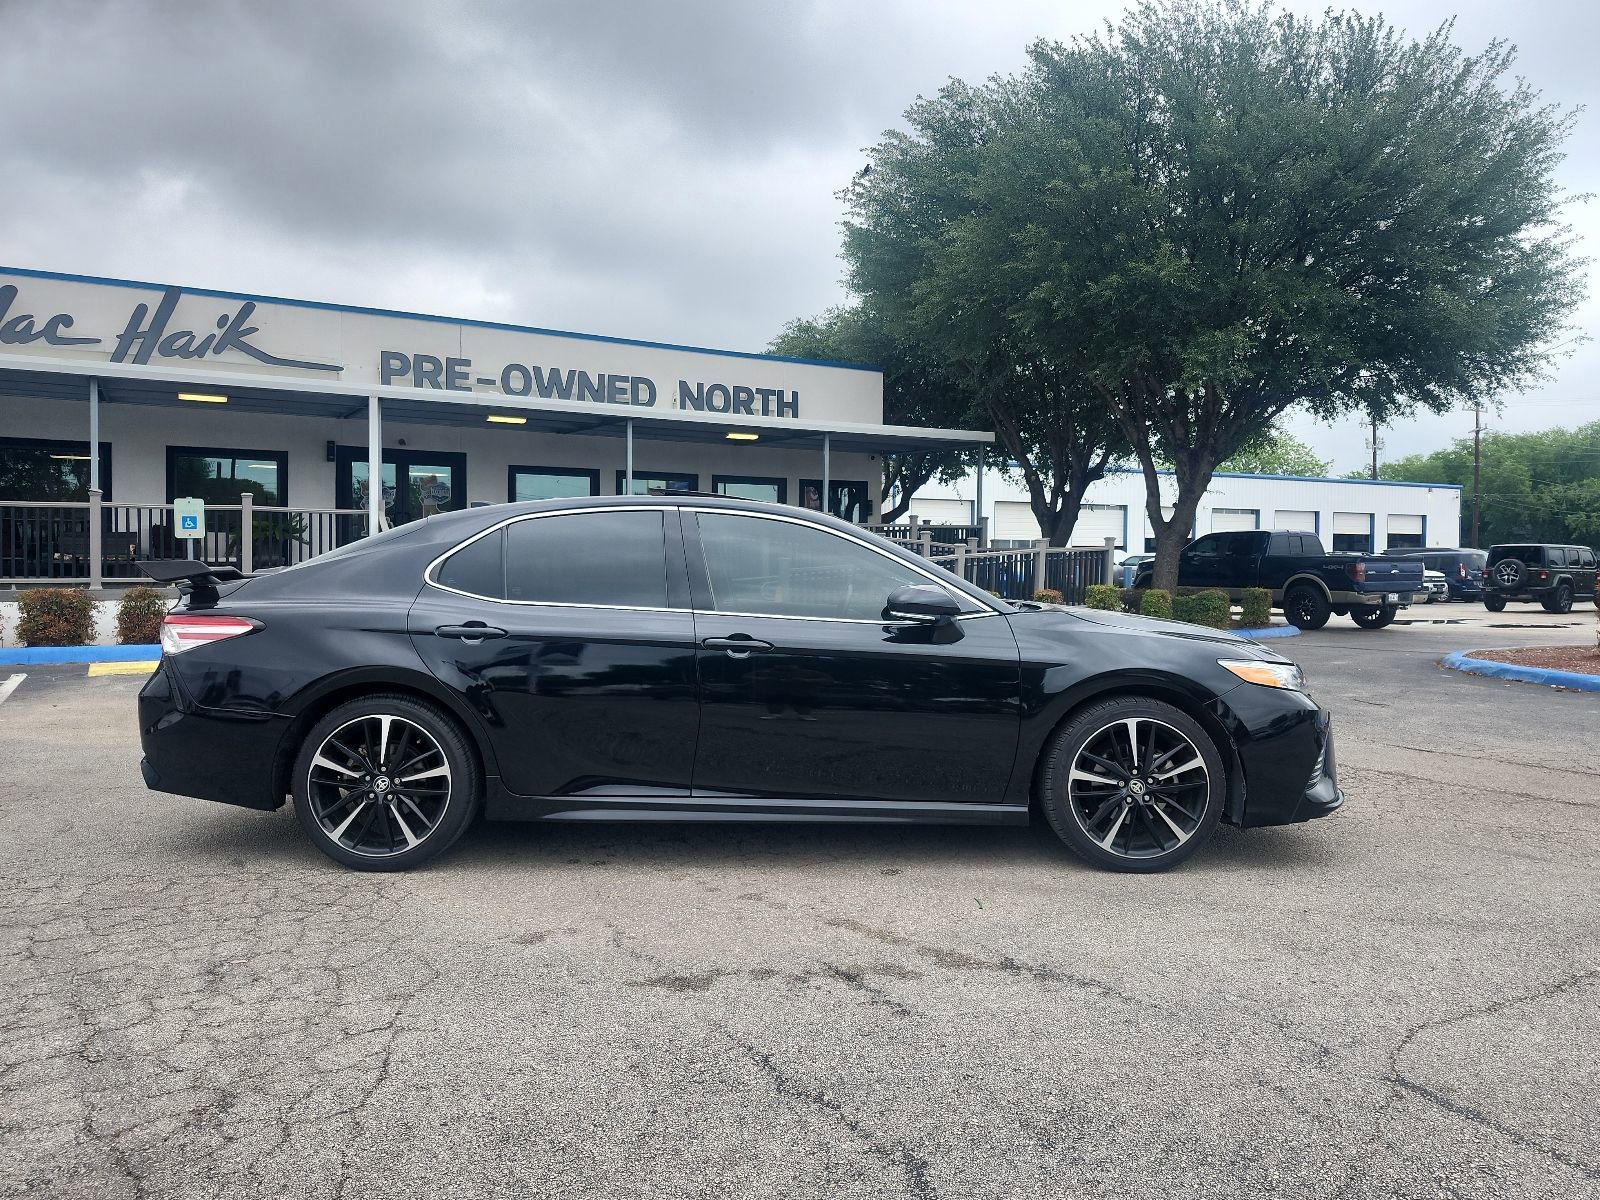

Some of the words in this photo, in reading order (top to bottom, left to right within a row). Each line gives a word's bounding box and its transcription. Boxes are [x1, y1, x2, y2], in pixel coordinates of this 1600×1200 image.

[110, 286, 344, 371] Haik
[380, 350, 657, 407] PRE-OWNED
[678, 380, 799, 418] NORTH
